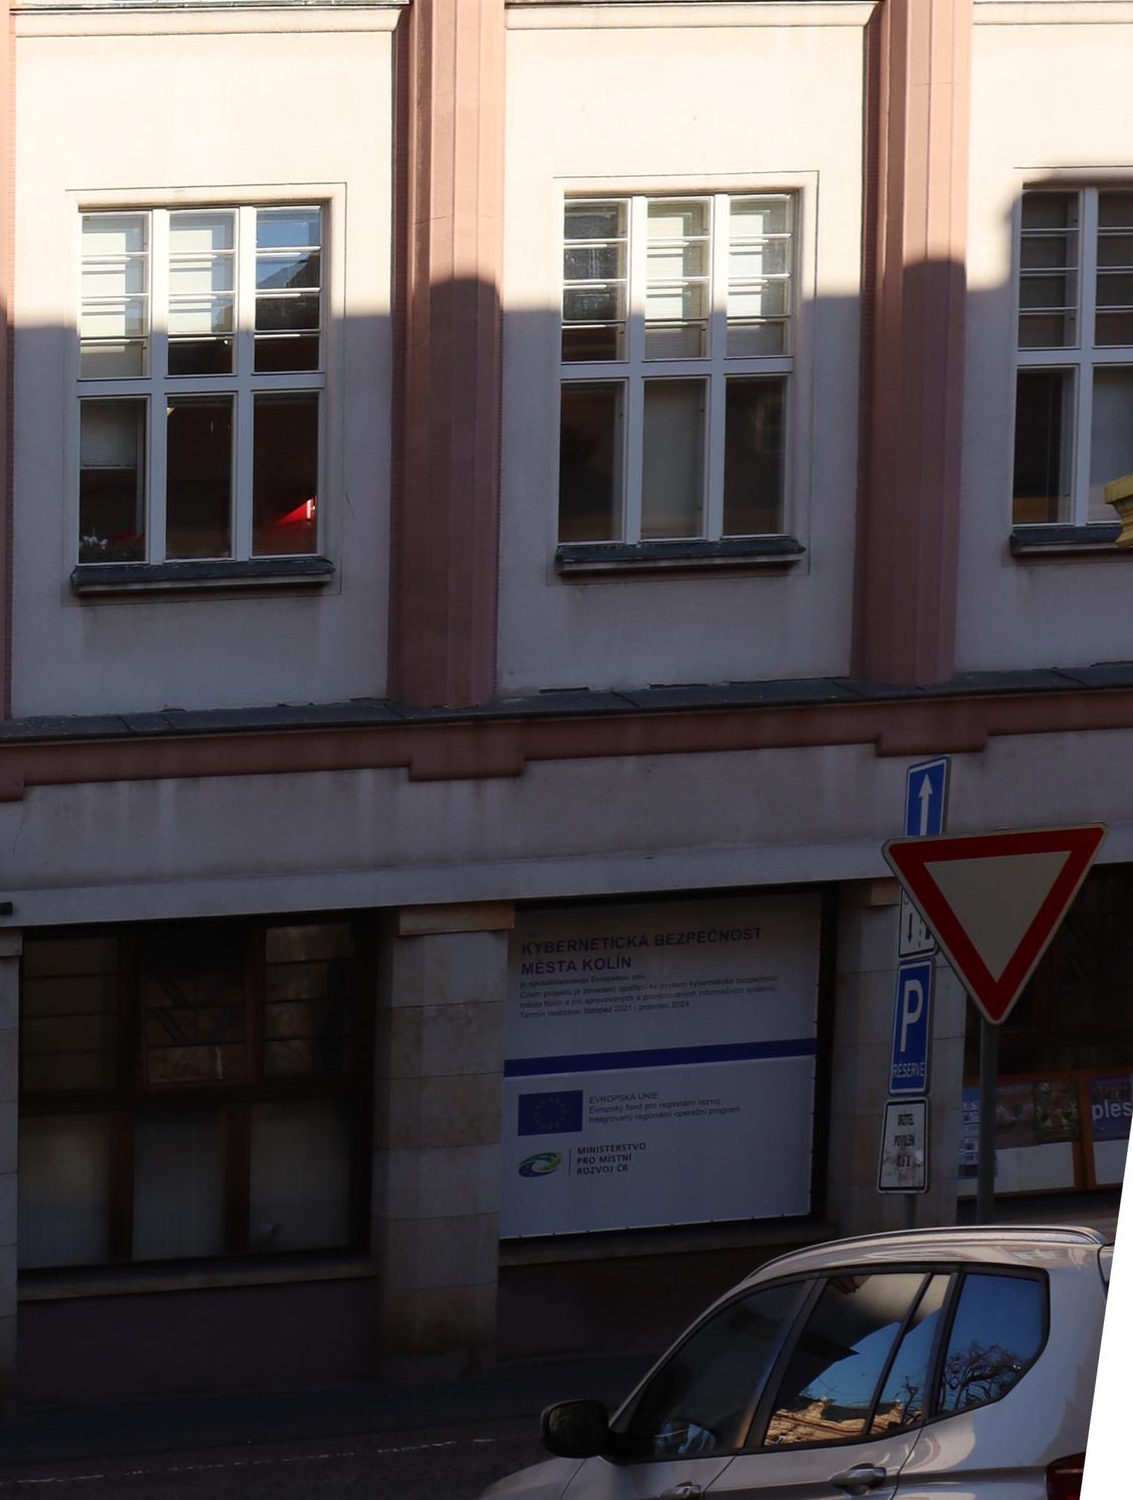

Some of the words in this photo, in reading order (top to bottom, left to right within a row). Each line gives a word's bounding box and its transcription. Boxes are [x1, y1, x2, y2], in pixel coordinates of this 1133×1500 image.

[522, 932, 648, 955] KYBERNETICKÁ
[654, 926, 762, 947] BEZPEČNOST
[521, 958, 577, 975] MĚSTA
[583, 953, 631, 970] KOLÍN
[900, 979, 923, 1053] P
[577, 1142, 646, 1154] MINISTERSTVO
[577, 1156, 595, 1164] PRO
[577, 1164, 613, 1175] ROZVOJ
